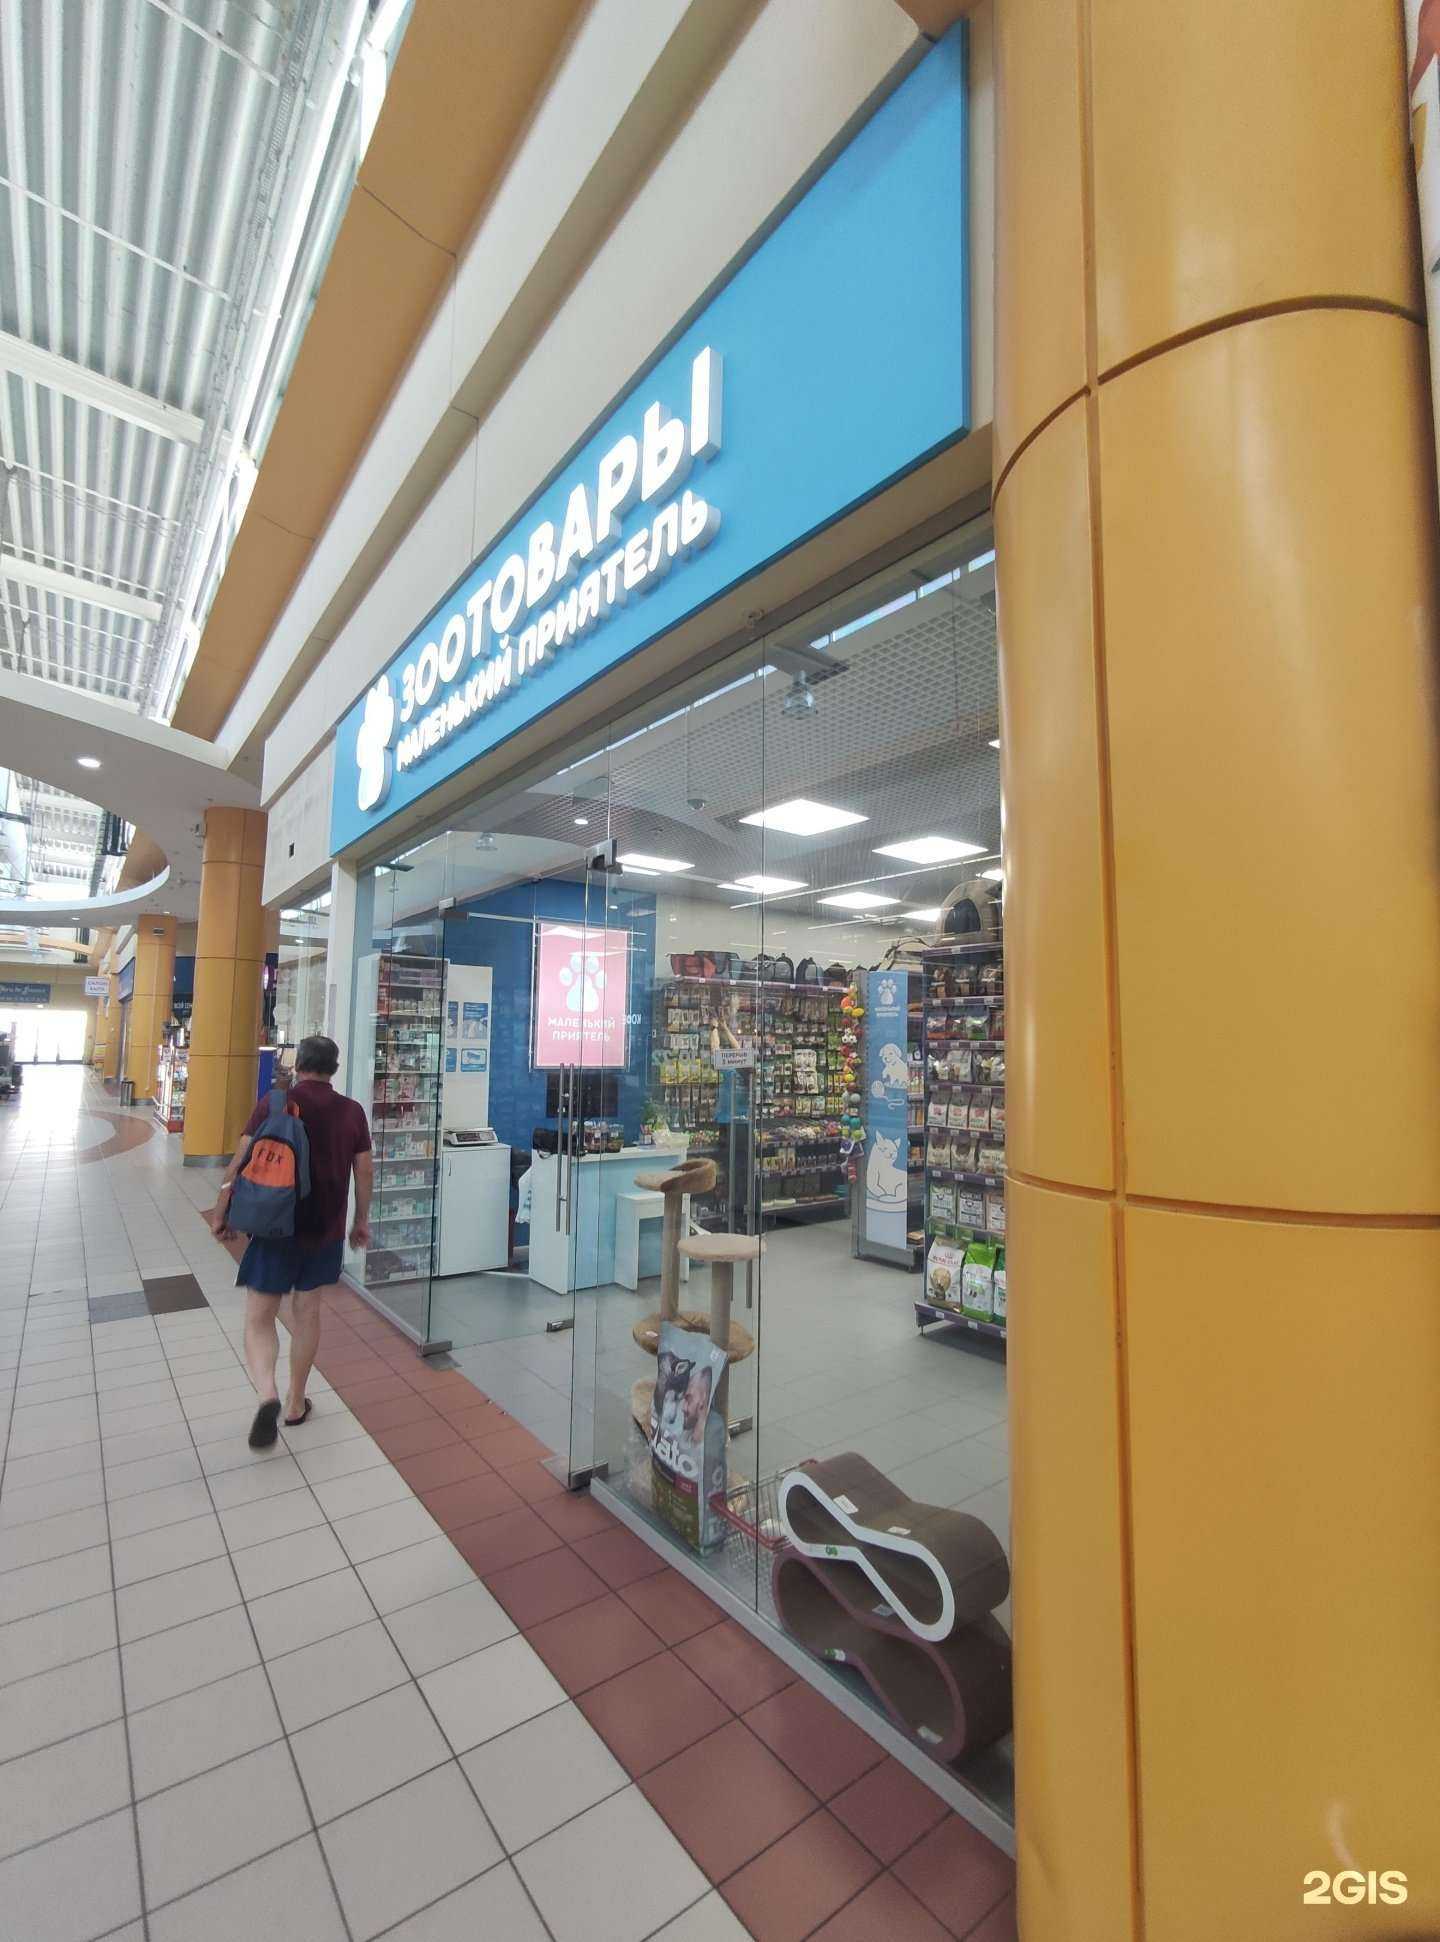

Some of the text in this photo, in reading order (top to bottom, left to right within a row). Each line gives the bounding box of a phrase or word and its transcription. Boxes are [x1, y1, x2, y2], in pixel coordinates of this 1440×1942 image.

[396, 489, 709, 772] МАЛЕНЬКИЙ ПРИЯТЕЛЬ
[399, 345, 712, 722] ЗООТОВАРЫ
